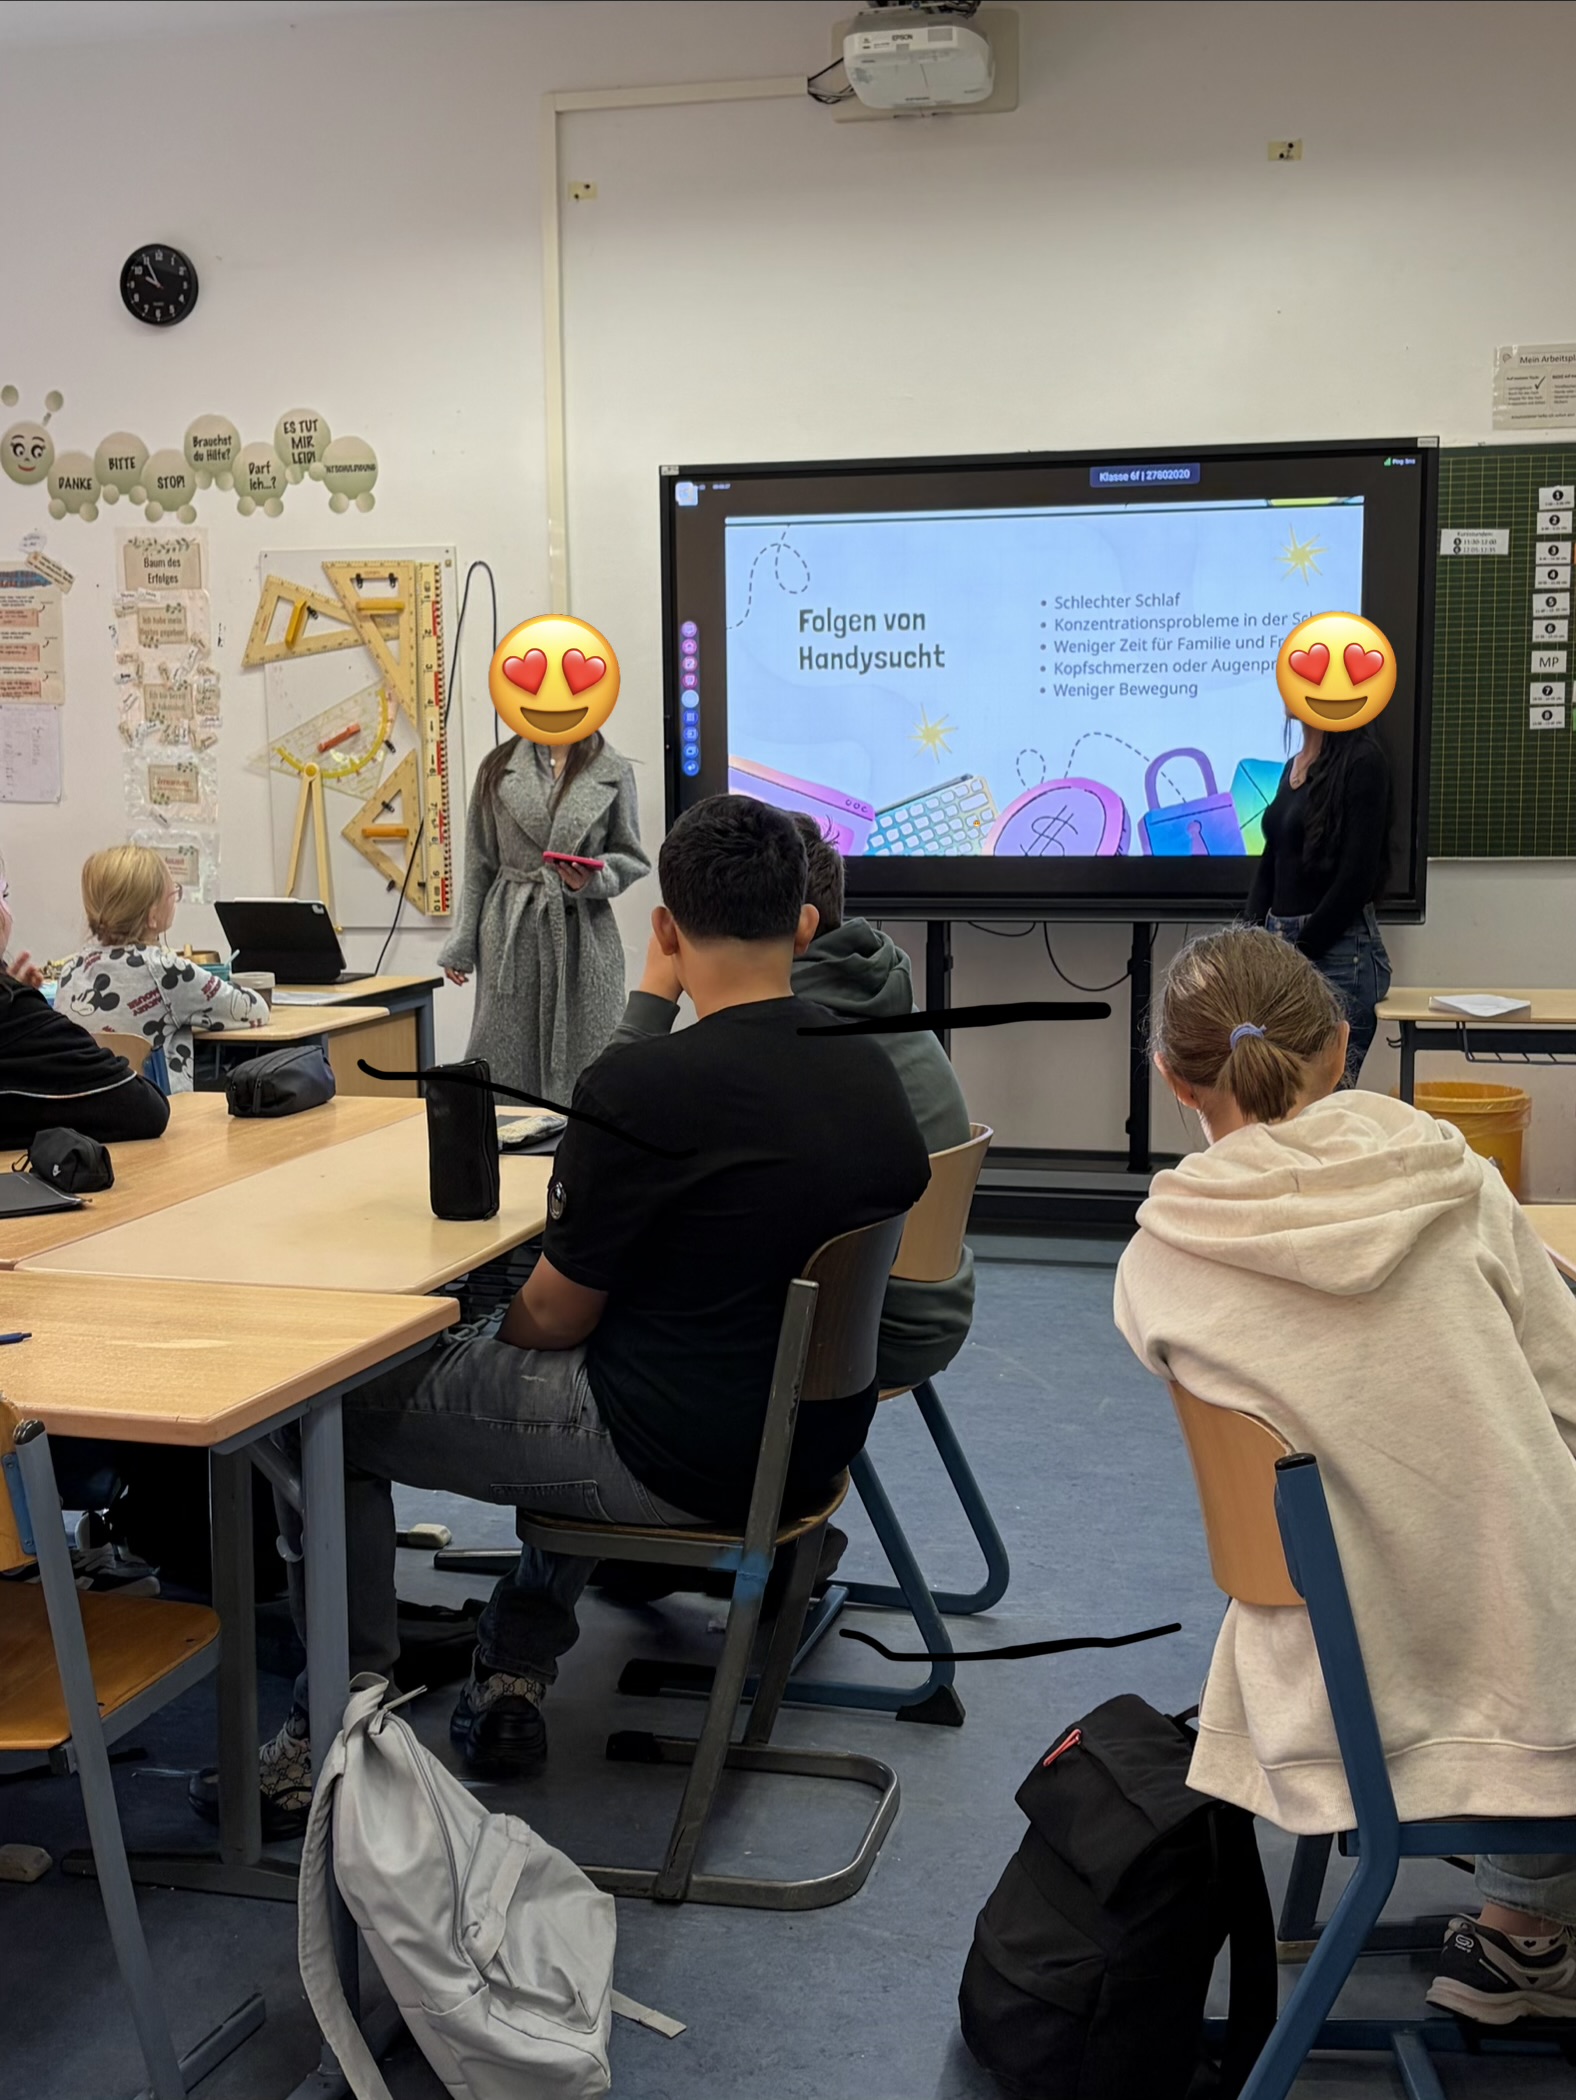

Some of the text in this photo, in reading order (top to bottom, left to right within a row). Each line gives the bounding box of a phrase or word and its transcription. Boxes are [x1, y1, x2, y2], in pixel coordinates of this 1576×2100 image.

[891, 33, 913, 41] EPSON
[1520, 353, 1576, 364] Mein Arbeitspl
[283, 418, 319, 434] ES TUT
[192, 434, 232, 448] Brauchst
[291, 435, 315, 450] MIR
[193, 448, 231, 462] du Hilfe?
[291, 451, 317, 465] LEID!
[108, 456, 136, 471] BITTE
[248, 460, 271, 475] Darf
[58, 476, 93, 490] DANKE
[157, 475, 186, 489] STOP!
[1099, 471, 1129, 482] Klasse
[1130, 470, 1140, 481] 6f
[143, 556, 181, 568] Baum des
[147, 572, 179, 586] Erfolges
[1054, 592, 1181, 610] Schlechter Schlaf
[799, 607, 926, 639] Folgen von
[1054, 613, 1240, 632] Konzentrationsprobleme
[1243, 613, 1257, 627] in
[1261, 612, 1288, 626] der
[1053, 635, 1285, 657] Weniger Zeit für Familie und Fr
[799, 643, 946, 675] Handysucht
[1539, 656, 1559, 668] MP
[1053, 658, 1277, 679] Kopfschmerzen oder Augenpr
[1053, 682, 1198, 700] Weniger Bewegung
[434, 899, 441, 911] 10
